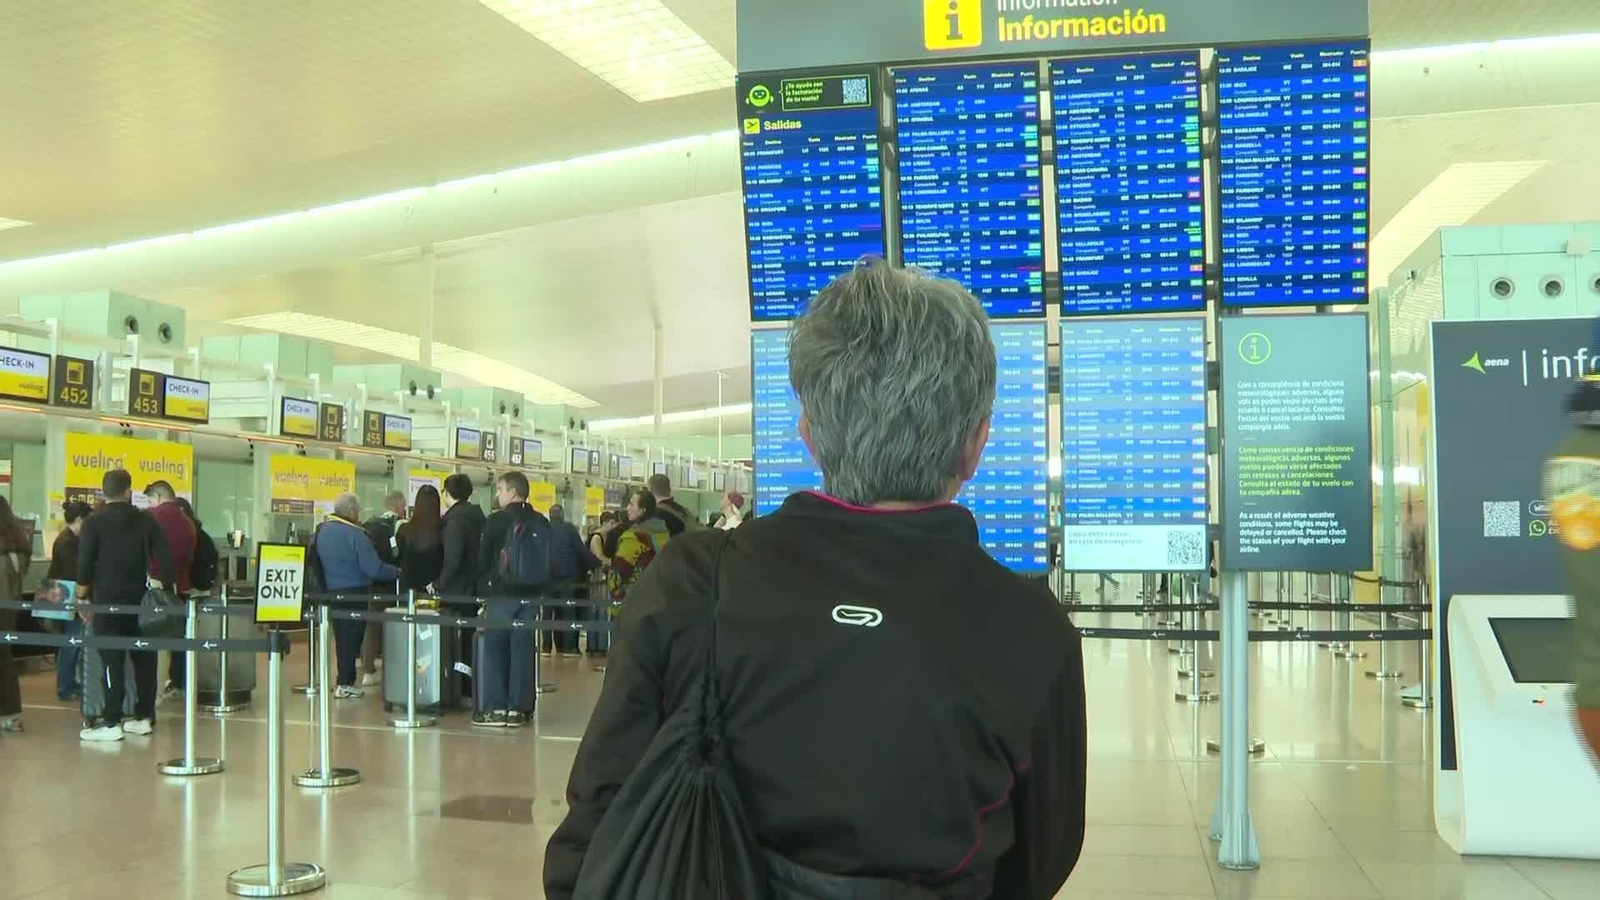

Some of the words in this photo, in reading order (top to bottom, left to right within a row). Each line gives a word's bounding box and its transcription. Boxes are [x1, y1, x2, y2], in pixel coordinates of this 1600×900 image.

[998, 8, 1166, 41] Información
[764, 120, 802, 130] Salidas
[0, 356, 34, 369] HECK-IN
[1484, 358, 1509, 367] aena
[60, 386, 88, 405] 452
[168, 384, 198, 394] CHECK-IN
[133, 398, 158, 414] 453
[324, 426, 340, 439] 454
[366, 433, 380, 444] 455
[73, 450, 125, 470] vueling
[139, 456, 184, 480] vueling
[1293, 520, 1314, 528] flights
[1240, 529, 1264, 537] delayed
[1297, 537, 1314, 545] flight
[266, 569, 296, 582] EXIT
[260, 585, 299, 599] ONLY
